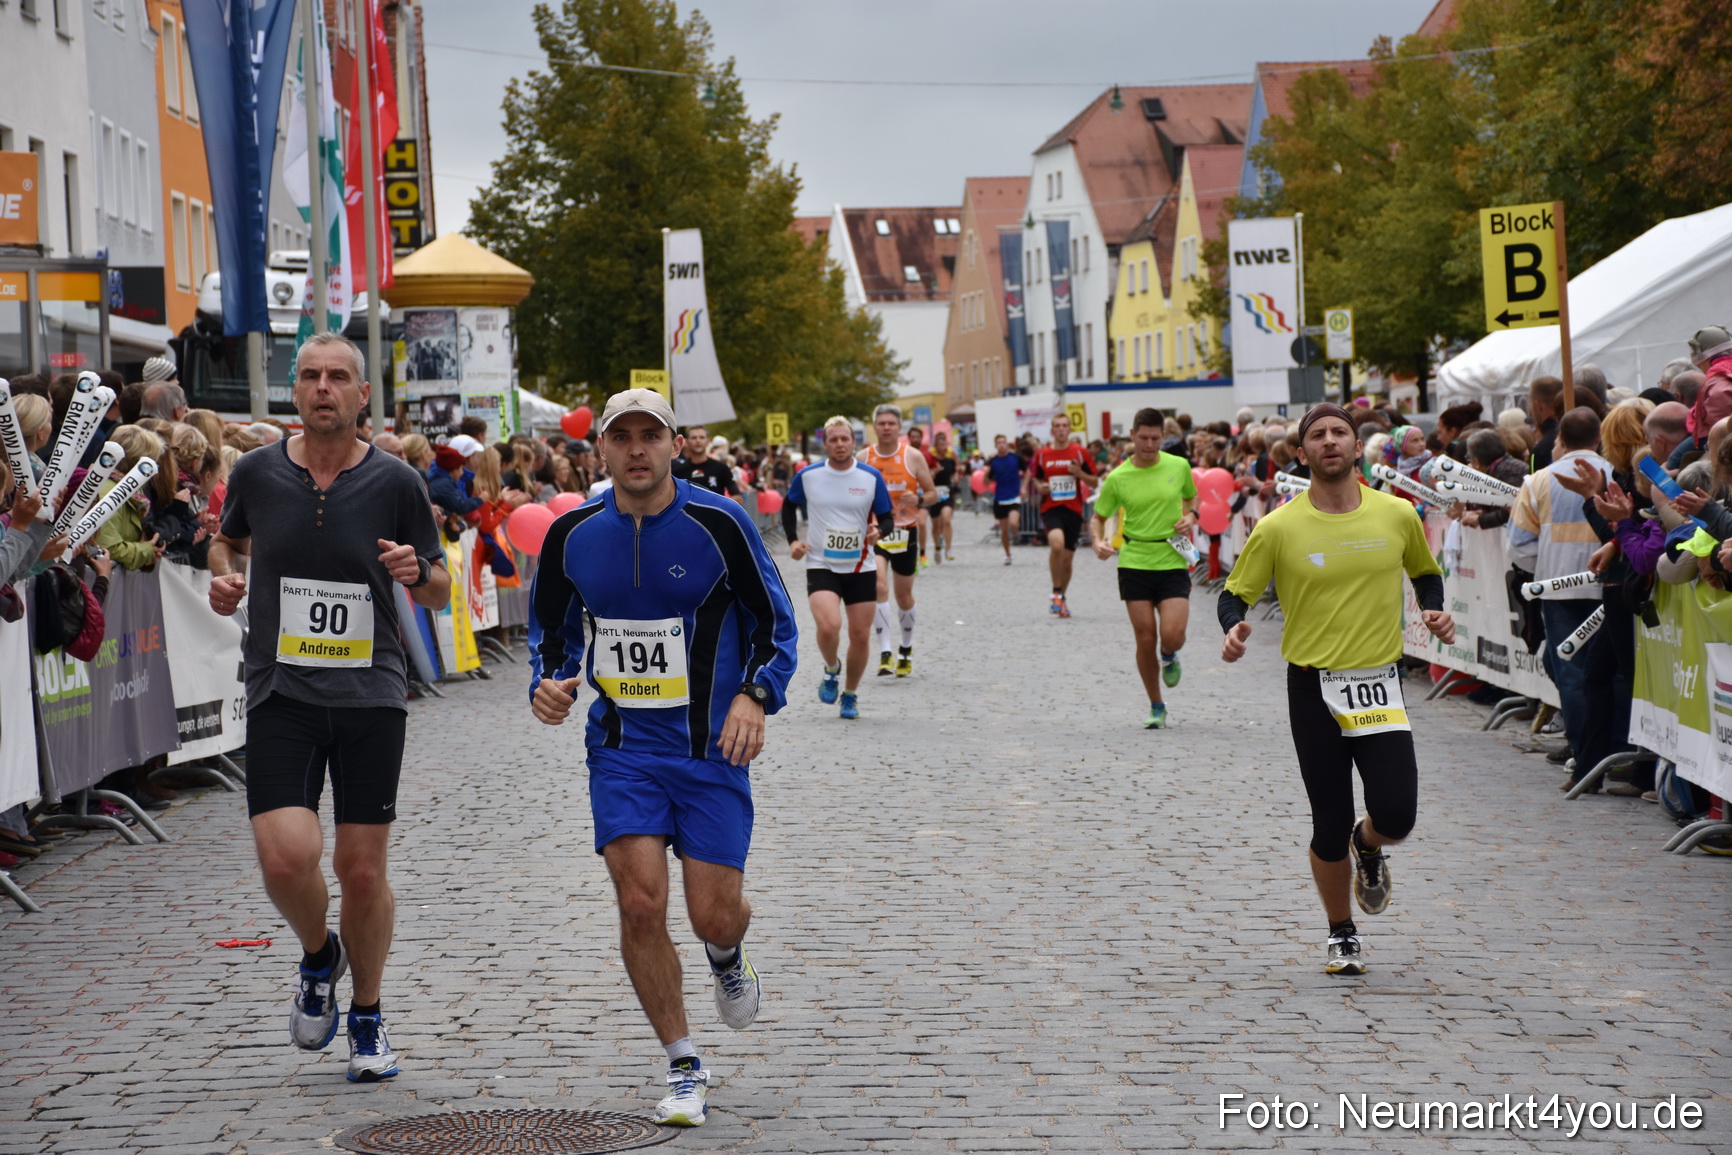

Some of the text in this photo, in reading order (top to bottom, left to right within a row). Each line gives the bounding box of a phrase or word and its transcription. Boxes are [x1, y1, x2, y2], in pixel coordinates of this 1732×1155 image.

[386, 142, 418, 244] HOT
[1491, 209, 1554, 235] Block
[669, 262, 699, 279] swn
[1504, 243, 1546, 303] B
[635, 372, 664, 383] Block
[61, 401, 84, 440] BMW
[1072, 412, 1083, 427] D
[0, 414, 20, 448] BMW
[773, 422, 783, 438] D
[77, 470, 103, 504] BMW
[1052, 482, 1074, 491] 2197
[50, 500, 84, 540] Laufsp
[67, 476, 139, 549] BMW Laufsport
[827, 535, 859, 549] 3024
[1551, 575, 1584, 591] BMW
[283, 586, 361, 601] PARTL Neumarkt
[309, 602, 348, 635] 90
[1576, 613, 1602, 640] BMW
[597, 628, 667, 637] ARTL Neumarkt
[299, 642, 350, 655] Andreas
[610, 641, 668, 673] 194
[1351, 674, 1386, 682] Neumarkt
[620, 683, 660, 695] Robert
[1340, 683, 1388, 709] 100
[1352, 713, 1388, 726] Tobias
